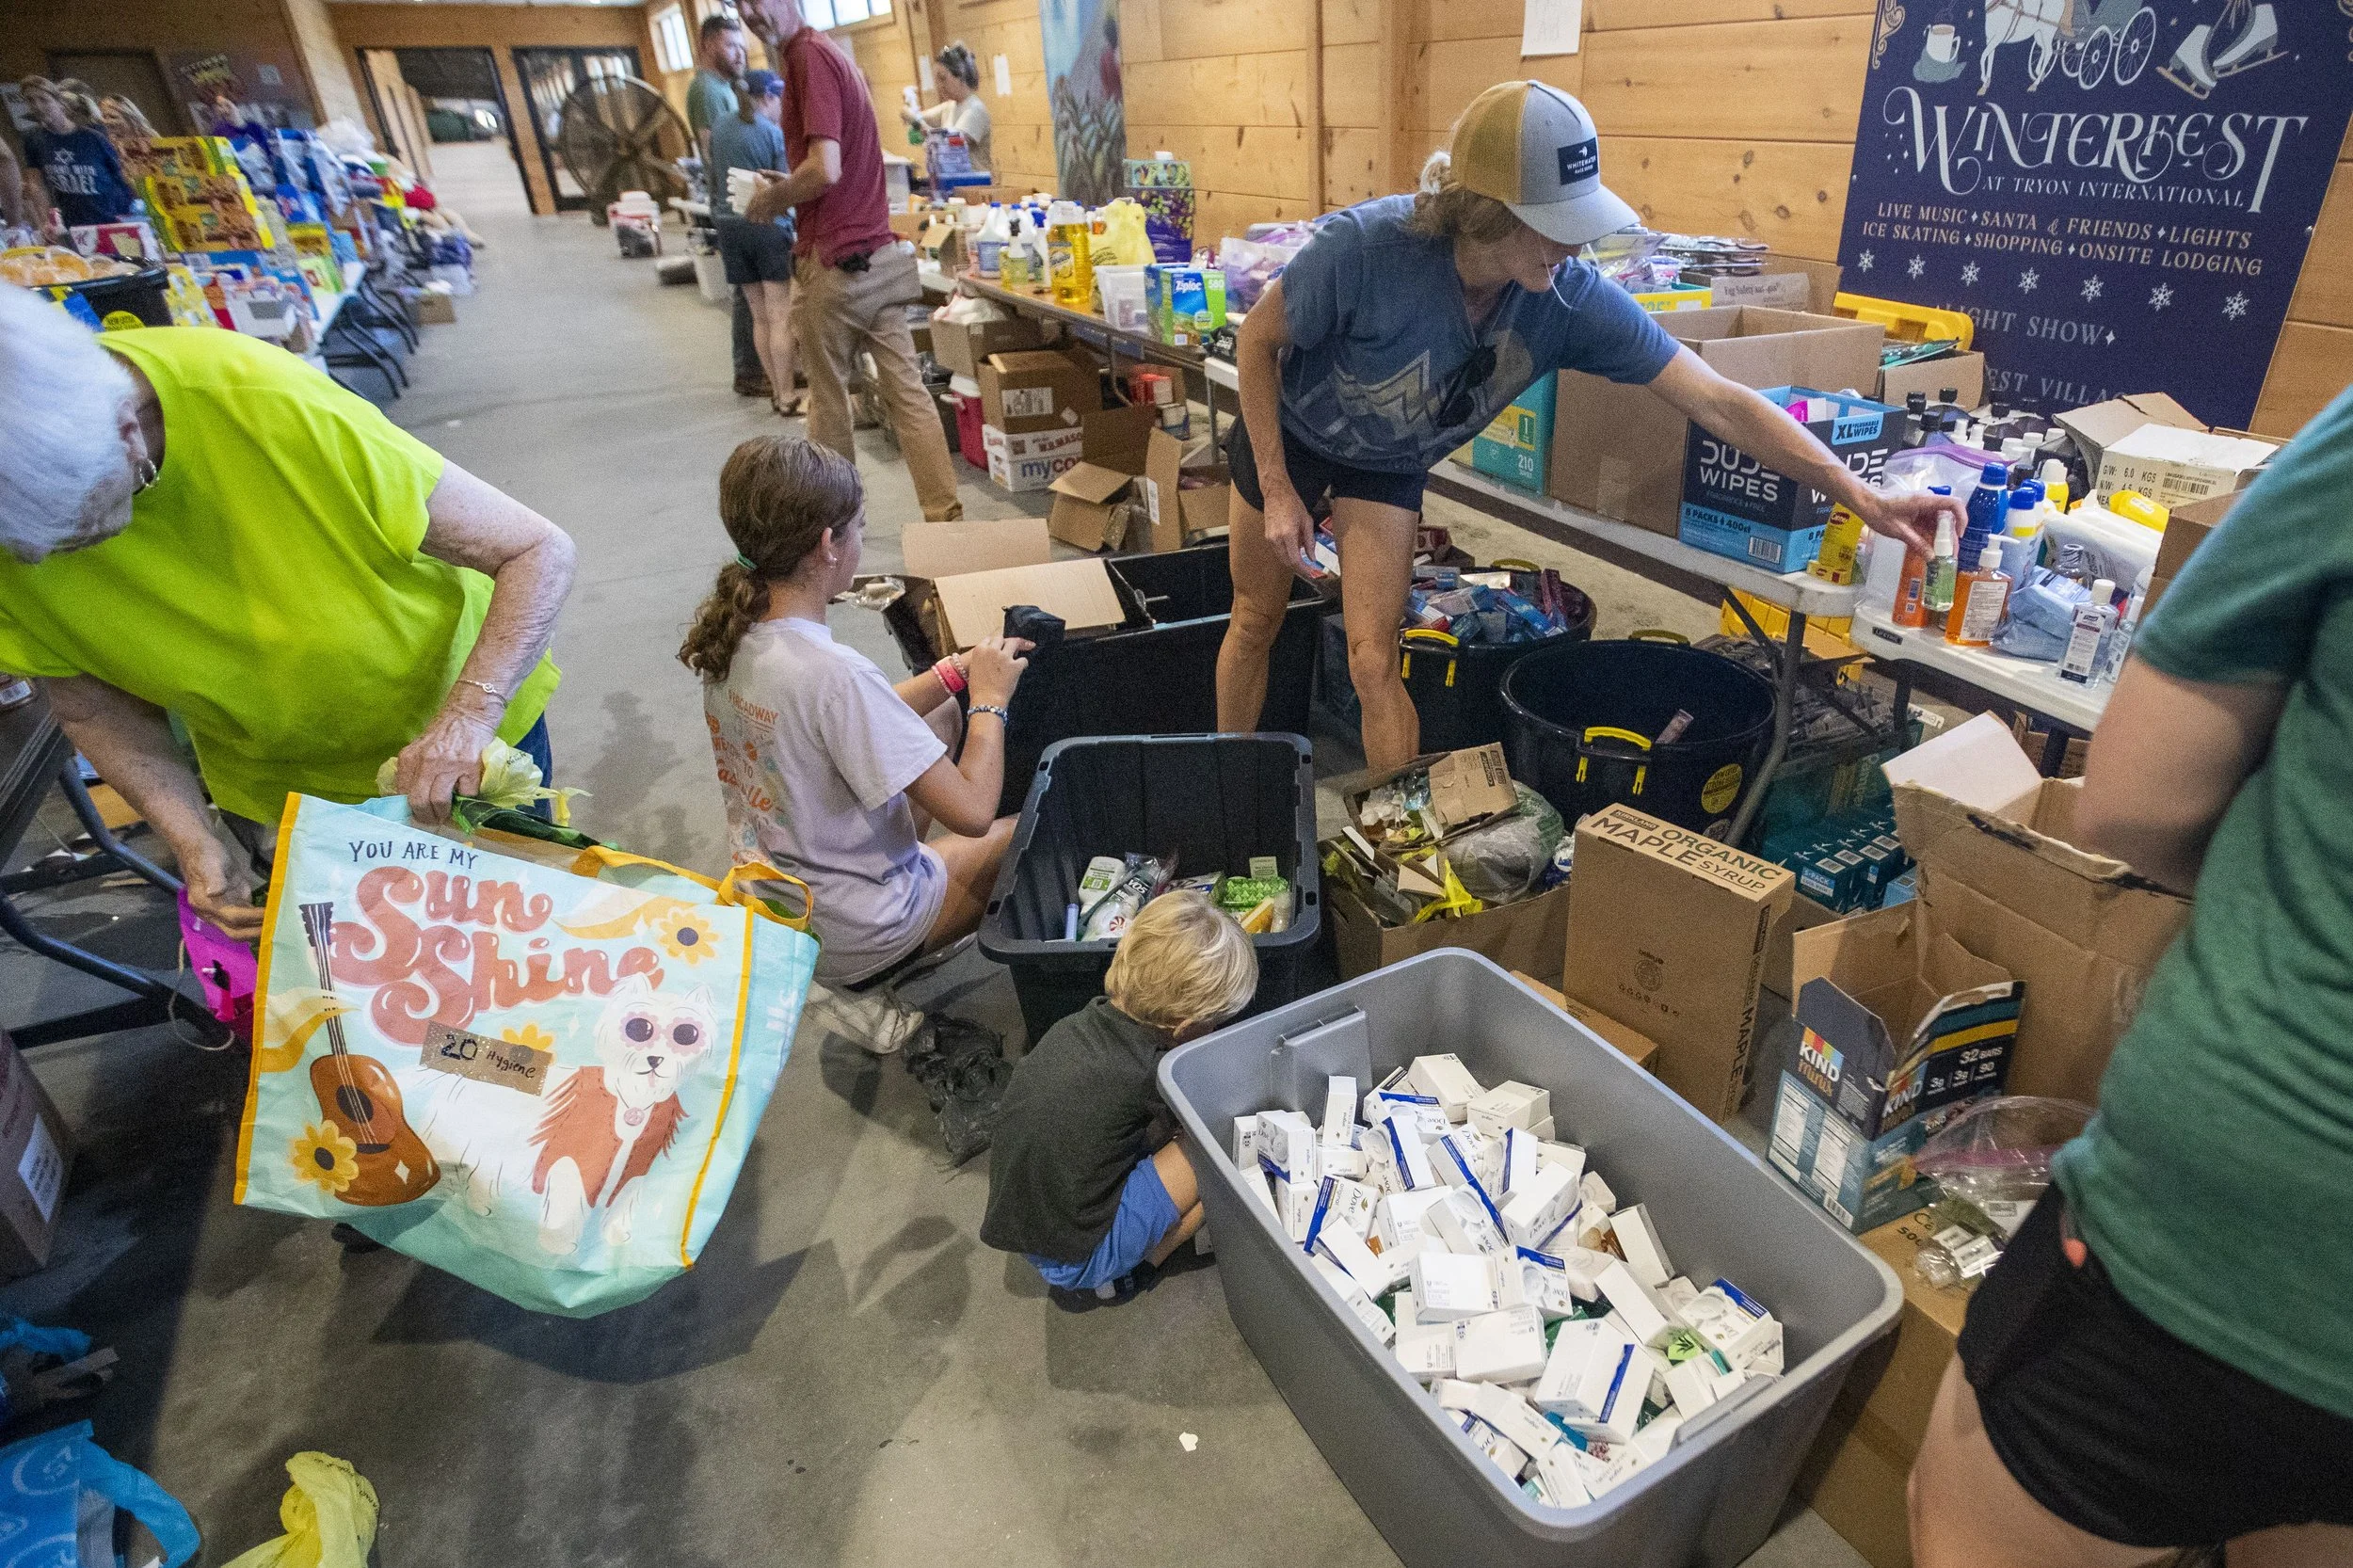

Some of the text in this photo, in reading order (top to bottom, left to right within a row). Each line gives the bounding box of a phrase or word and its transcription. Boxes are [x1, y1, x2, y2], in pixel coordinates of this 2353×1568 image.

[1883, 86, 2309, 214] WINTERFEST
[1982, 176, 2244, 207] AT TRYON INTERNATIONAL
[1878, 202, 2252, 249] LIVE MUSIC SANTA & FRIENDS LIGHTS
[1863, 221, 2263, 276] ICE SKATING SHOPPING ONSITE LODGING
[1175, 280, 1203, 293] Ziploc
[2026, 315, 2105, 345] SHOW
[2041, 377, 2125, 405] VILLA
[1836, 424, 1853, 440] XL
[1854, 426, 1878, 437] WIPES
[1021, 456, 1082, 480] myco
[1518, 454, 1533, 472] 210
[2123, 467, 2135, 479] 6.0
[2141, 471, 2157, 483] KGS
[1700, 465, 1779, 503] WIPES
[2138, 486, 2153, 499] KGS
[1692, 509, 1719, 524] PACKS
[1614, 810, 1657, 829] KIRKLAND
[348, 840, 479, 870] YOU ARE MY
[1590, 816, 1705, 867] MAPLE
[1661, 829, 1783, 880] ORGANIC
[1128, 879, 1148, 894] VO5
[1700, 860, 1767, 890] SYRUP
[328, 865, 553, 987] Sun
[371, 924, 665, 1047] Shine
[440, 1034, 536, 1079] 20 Hygiene
[1732, 1006, 1755, 1080] MAPLE
[1959, 1048, 1979, 1064] 32
[1799, 1041, 1840, 1082] KIND
[1349, 1187, 1364, 1214] Dove
